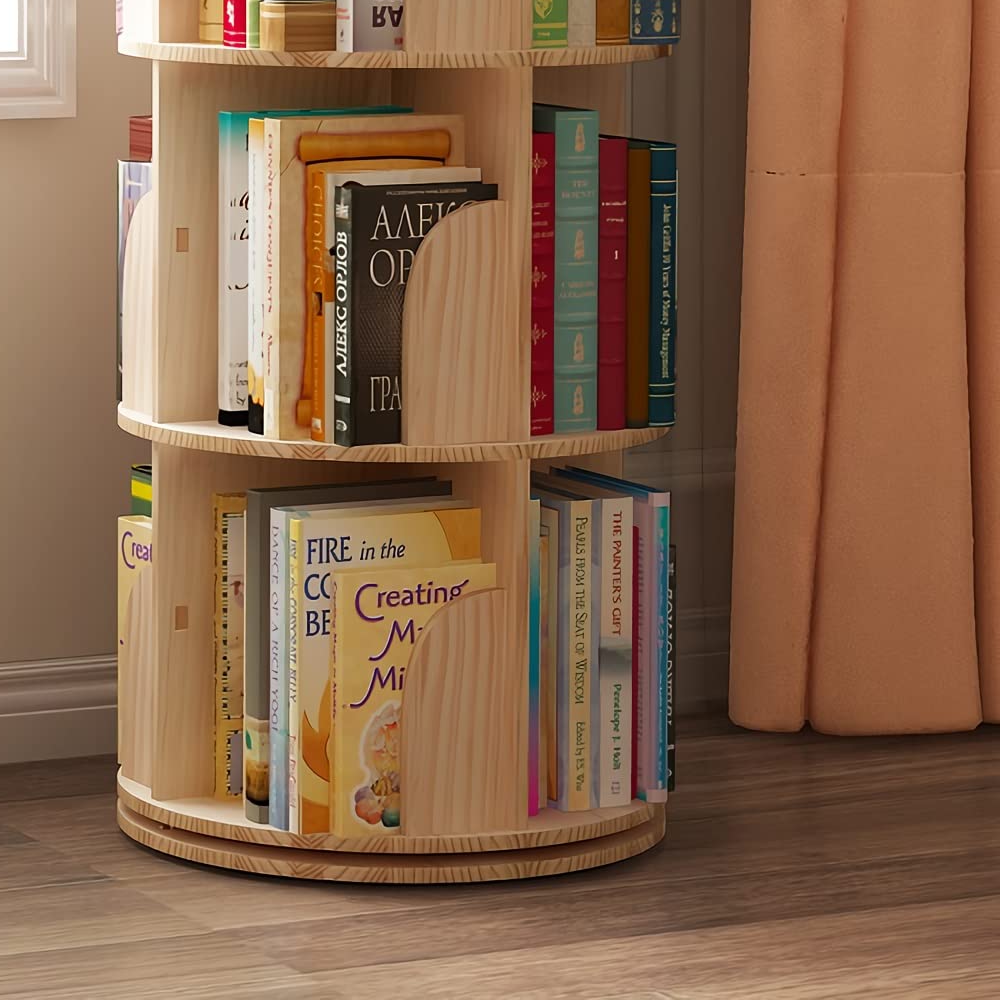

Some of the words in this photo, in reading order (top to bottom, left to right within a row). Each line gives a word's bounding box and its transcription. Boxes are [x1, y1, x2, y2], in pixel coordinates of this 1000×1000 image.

[336, 231, 348, 303] ОРЛОВ
[336, 306, 348, 378] АЛЕКС
[660, 327, 670, 378] Management
[575, 516, 588, 555] PEARLS
[612, 511, 622, 536] THE
[272, 526, 280, 584] DANCE
[306, 536, 352, 565] FIRE
[360, 540, 375, 560] in
[380, 538, 406, 559] the
[575, 558, 586, 587] FROM
[612, 540, 622, 604] PAINTER'S
[272, 592, 280, 616] OF
[354, 579, 470, 622] Creating
[575, 588, 586, 610] THE
[272, 624, 279, 632] A
[612, 607, 622, 636] GIFT
[575, 642, 585, 655] OF
[574, 658, 588, 704] WISDOM
[610, 684, 622, 732] Penelope
